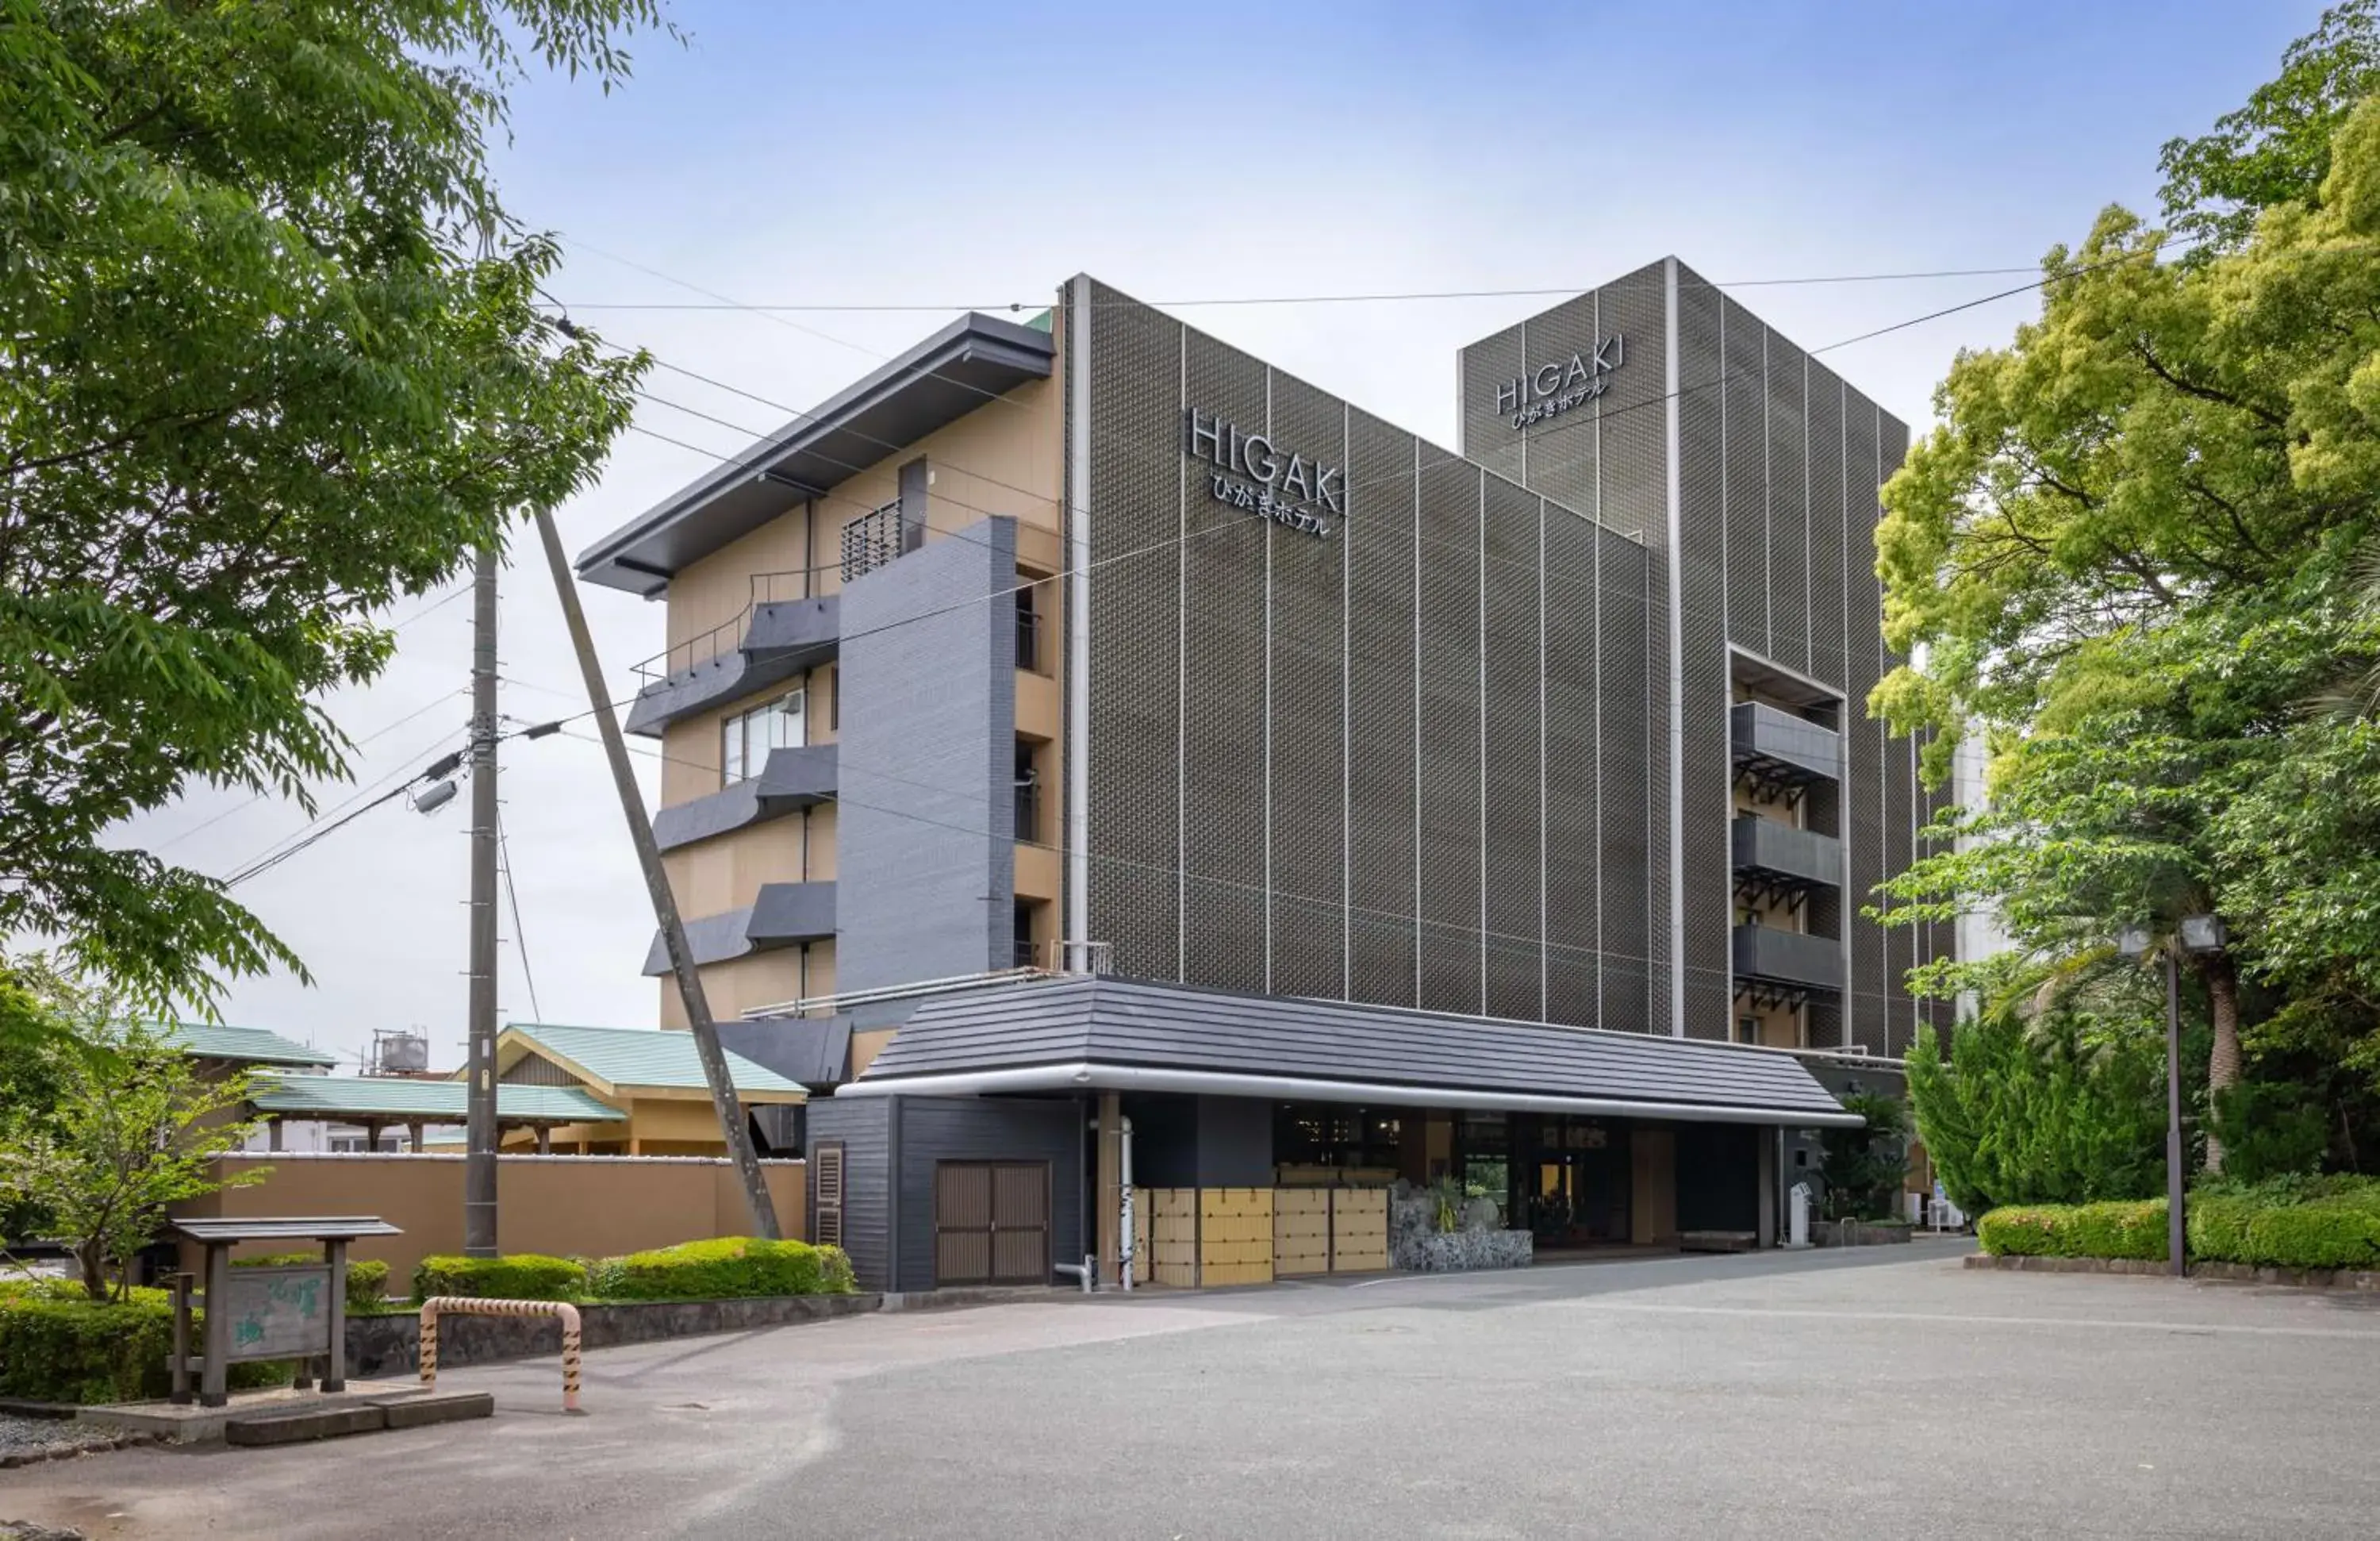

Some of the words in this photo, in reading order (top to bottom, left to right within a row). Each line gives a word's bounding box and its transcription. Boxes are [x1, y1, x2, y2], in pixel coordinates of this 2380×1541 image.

[1497, 332, 1623, 415] HIGAKI
[1214, 475, 1330, 535] ひがきホテル
